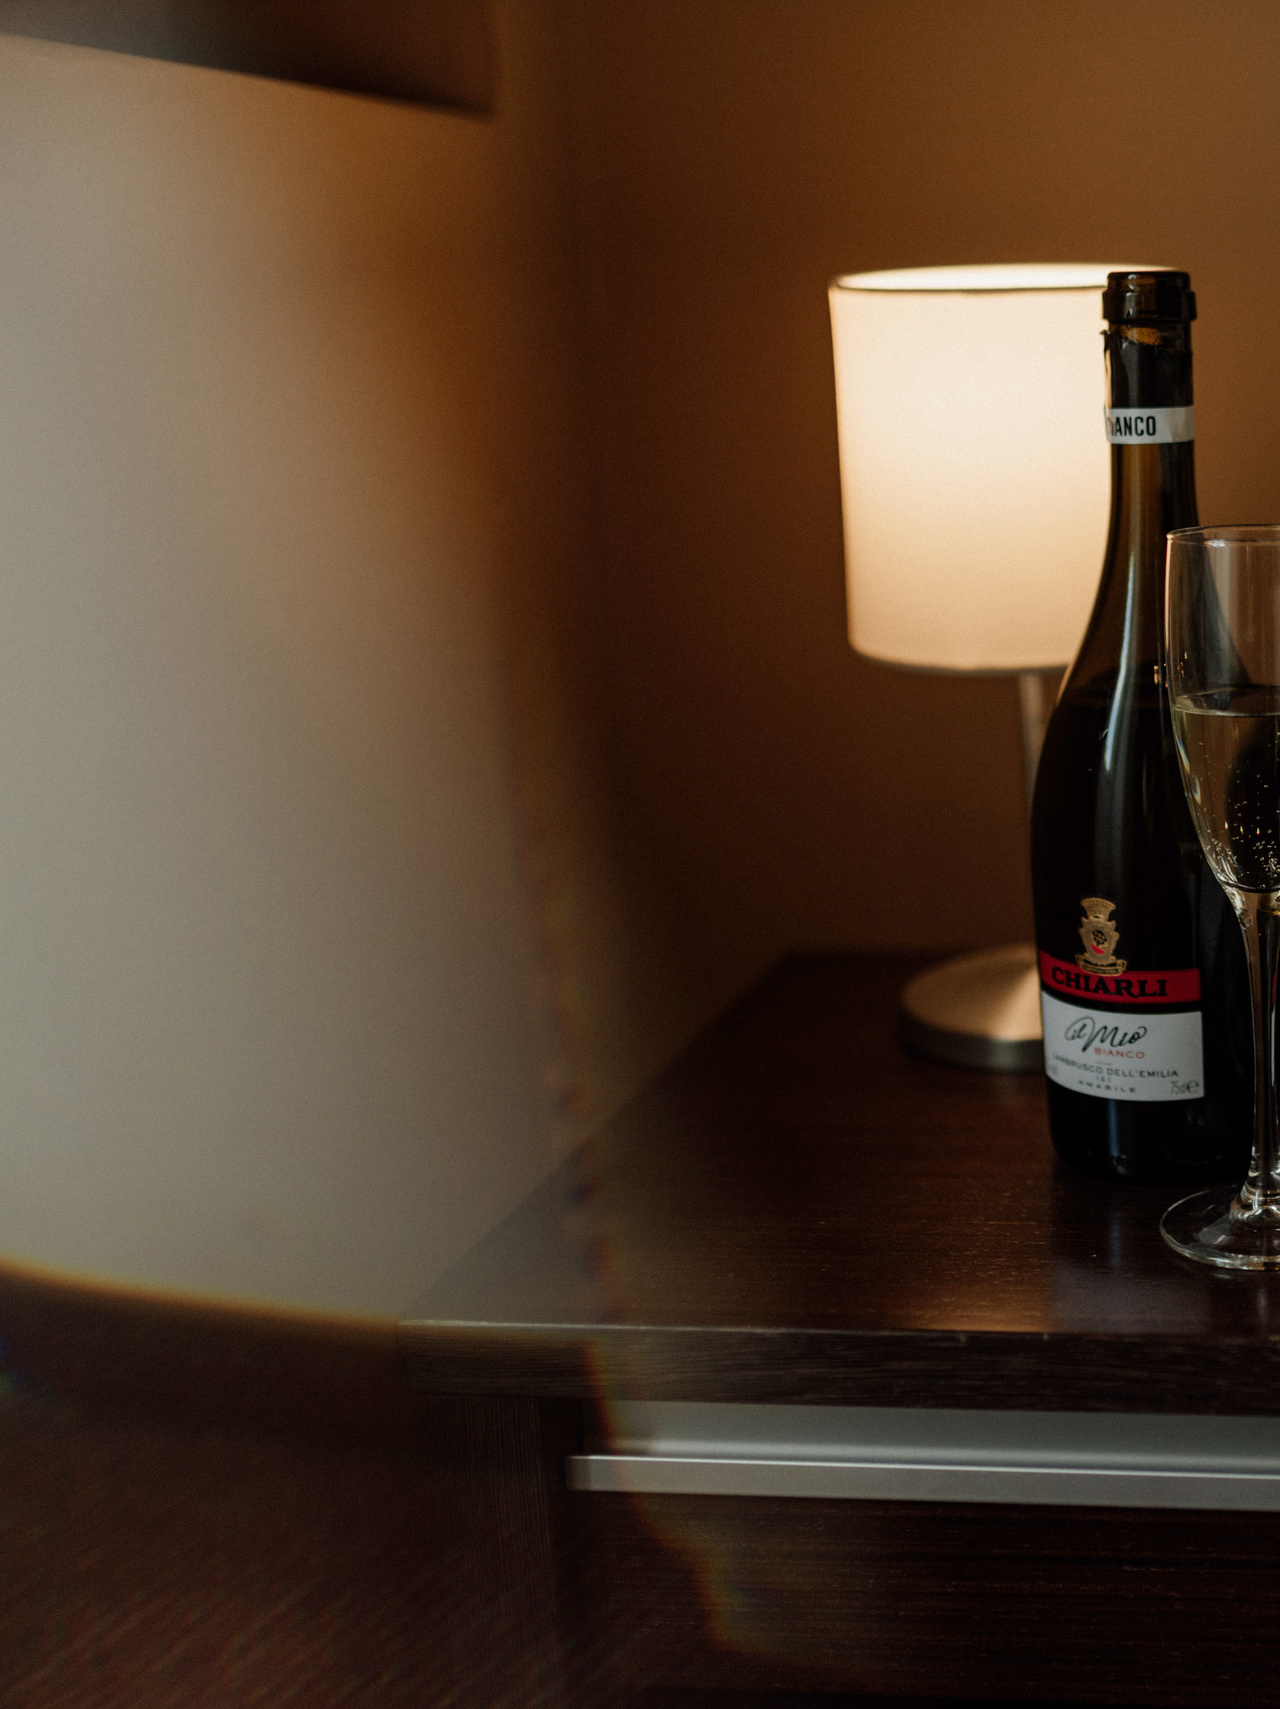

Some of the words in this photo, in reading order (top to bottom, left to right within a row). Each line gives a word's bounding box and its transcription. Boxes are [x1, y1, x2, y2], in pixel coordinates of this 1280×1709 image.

[1052, 966, 1168, 998] CHIARLI
[1094, 1047, 1145, 1059] BIANCO
[1106, 1067, 1178, 1079] DELL'EMILIA
